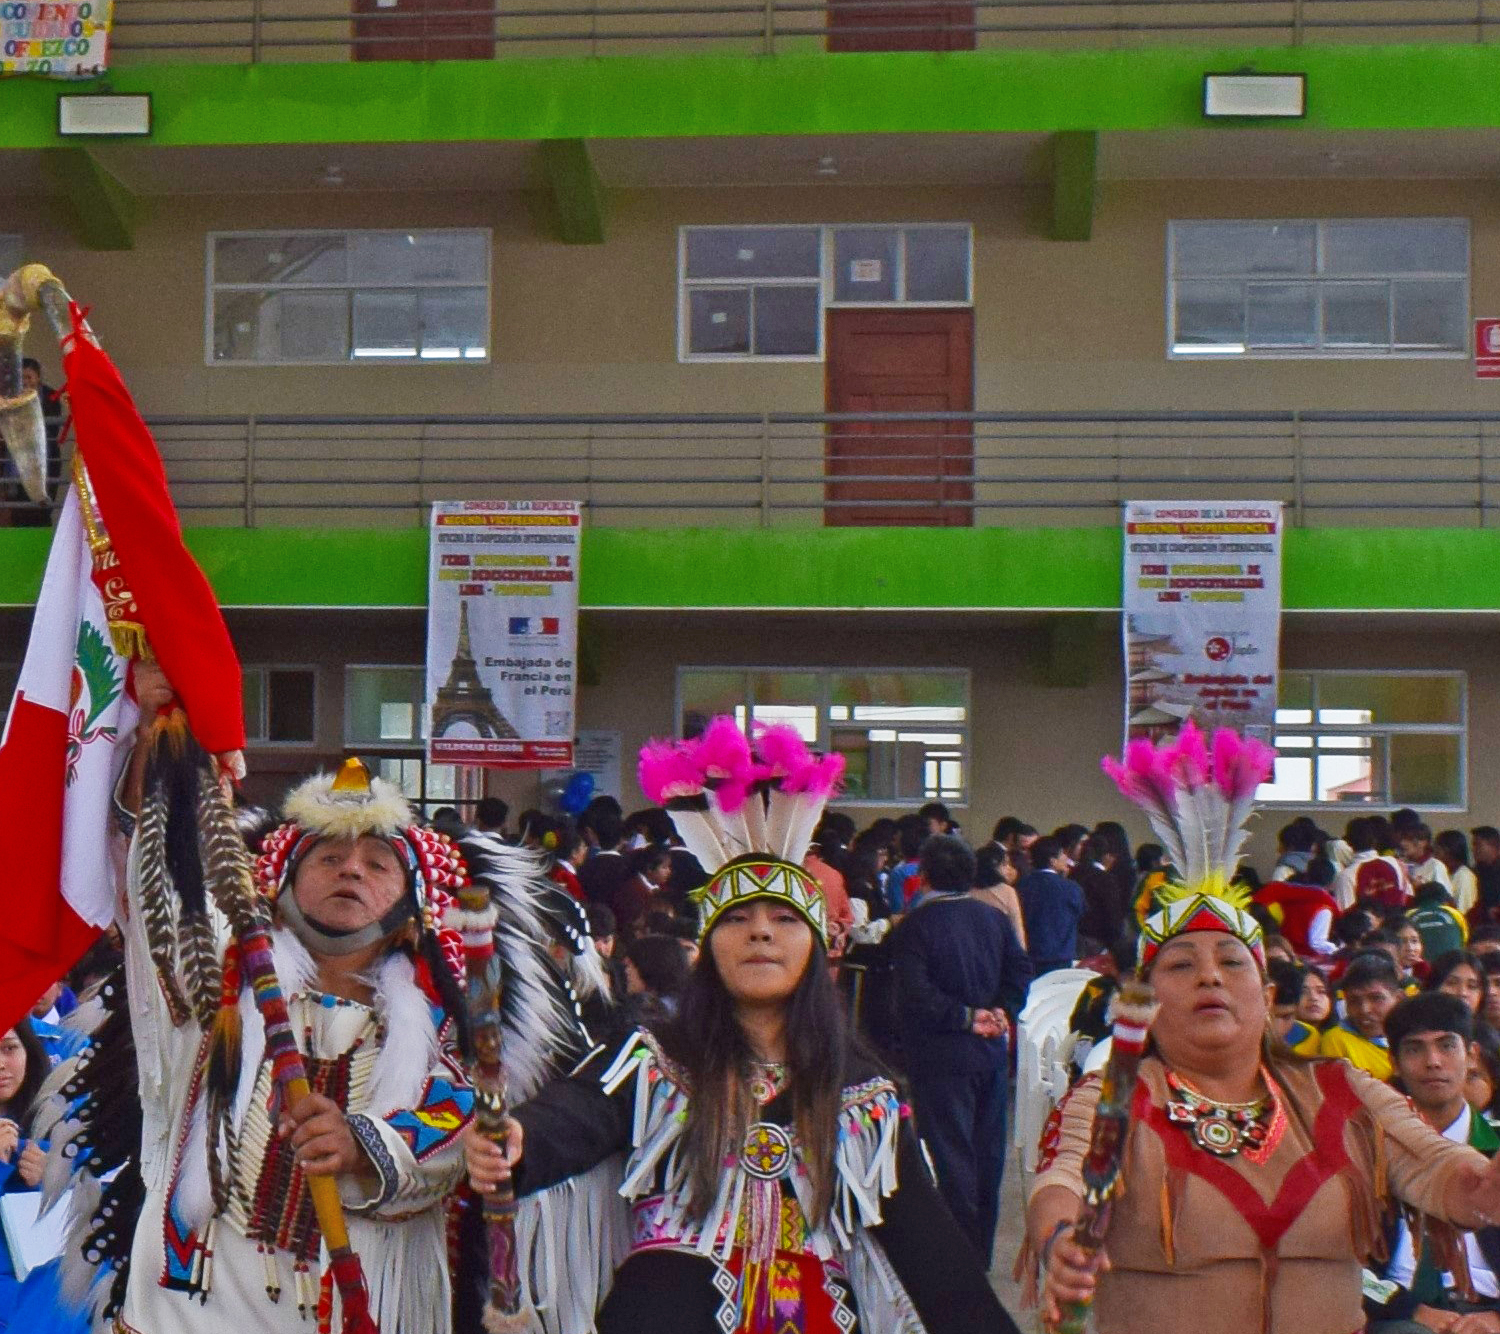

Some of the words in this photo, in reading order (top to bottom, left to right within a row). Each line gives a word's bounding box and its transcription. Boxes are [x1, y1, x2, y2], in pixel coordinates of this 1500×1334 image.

[485, 657, 551, 669] Embajada
[555, 657, 571, 668] de
[501, 671, 551, 681] Francia
[555, 672, 571, 681] en
[524, 685, 537, 695] el
